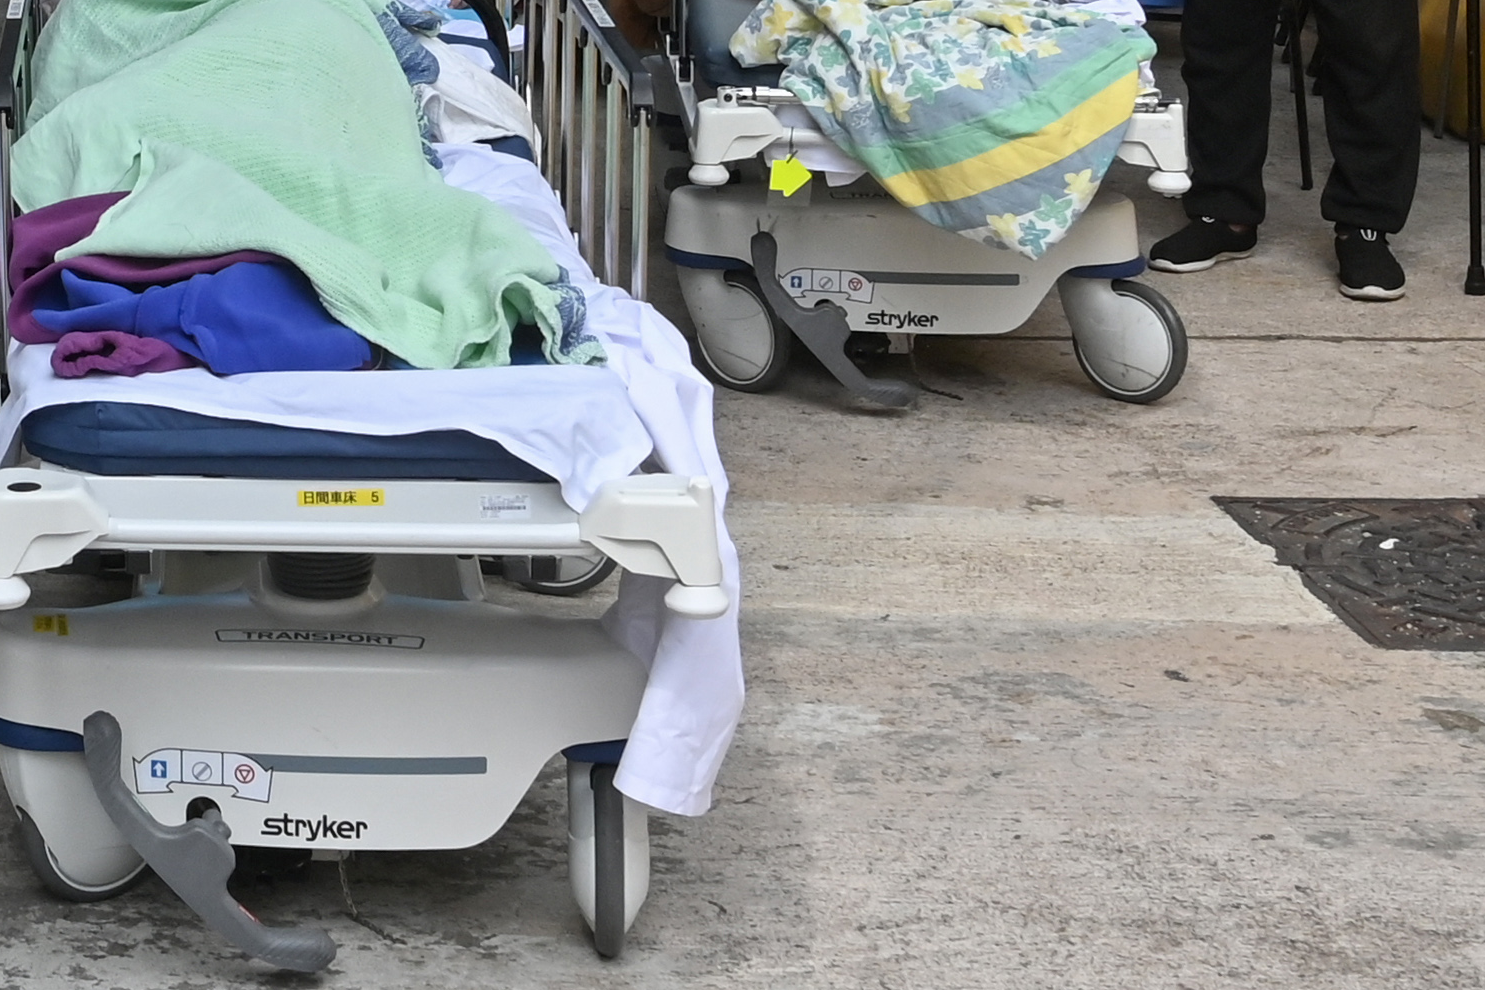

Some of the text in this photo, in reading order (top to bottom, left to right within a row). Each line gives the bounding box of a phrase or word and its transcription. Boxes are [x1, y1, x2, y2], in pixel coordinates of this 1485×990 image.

[865, 309, 939, 329] stryker
[303, 490, 379, 505] 日間車床 5
[242, 630, 398, 645] TRANSPORT
[260, 813, 368, 842] stryker
